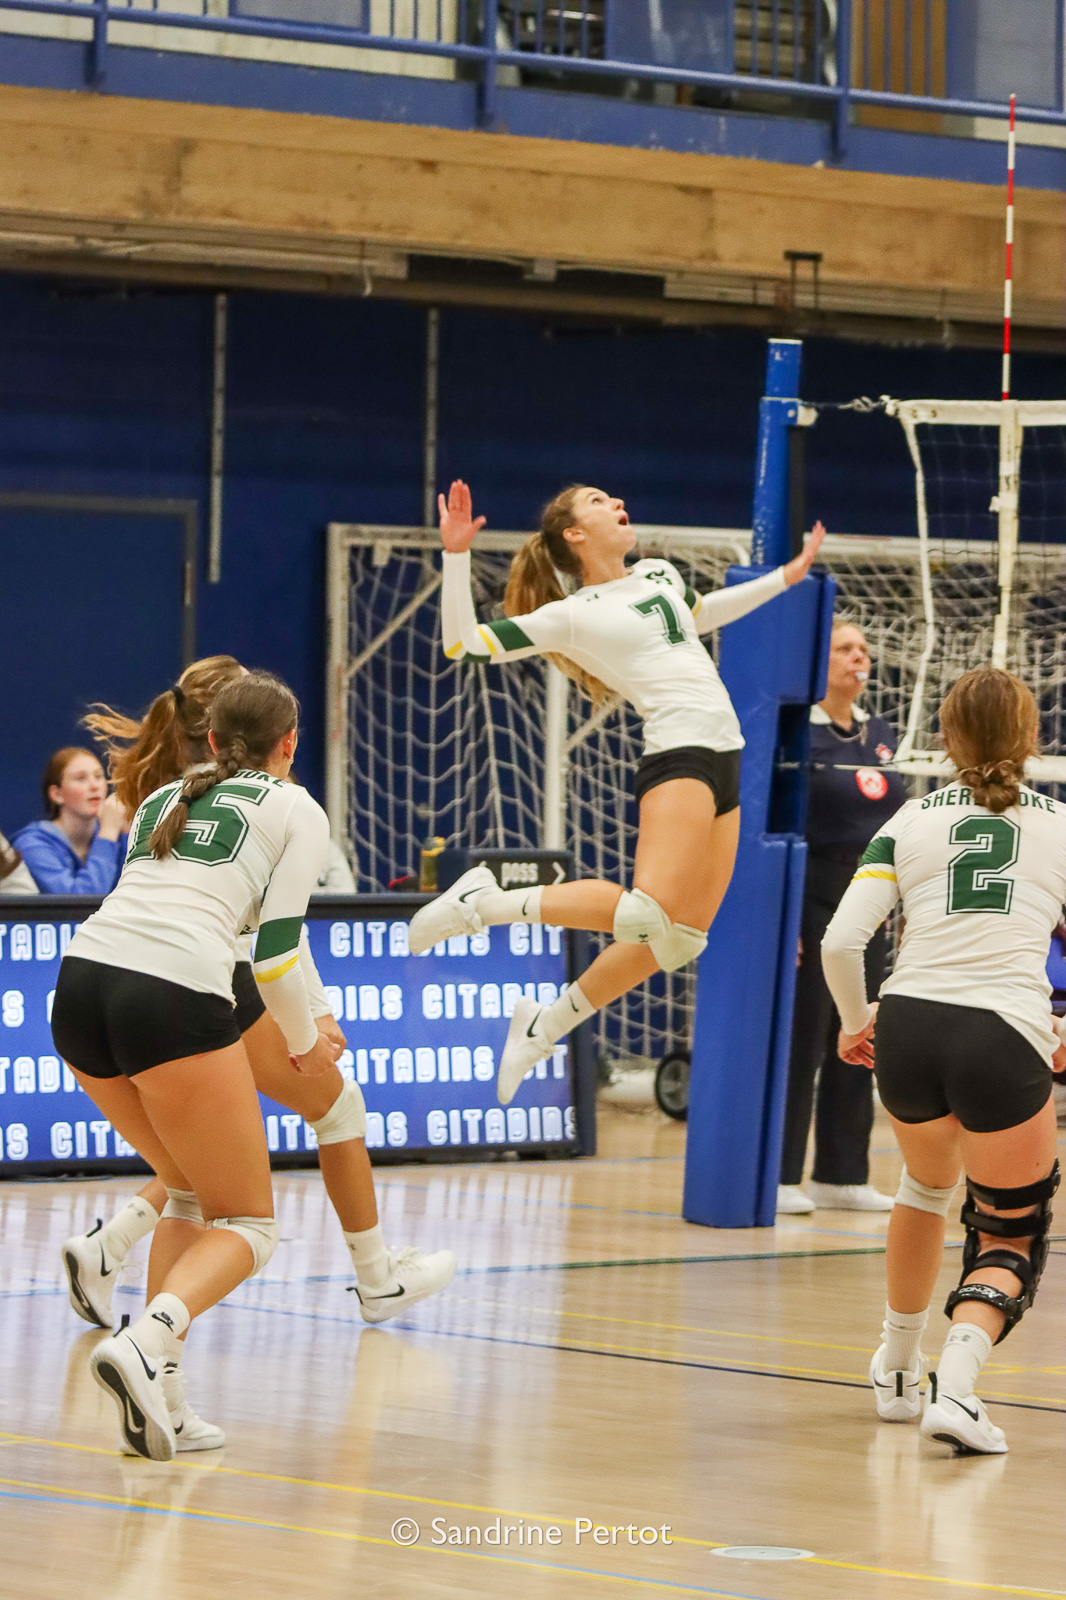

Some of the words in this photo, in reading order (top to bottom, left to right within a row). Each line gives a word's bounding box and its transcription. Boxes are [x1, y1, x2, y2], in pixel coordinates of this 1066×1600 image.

[627, 591, 691, 648] 7
[124, 782, 270, 868] 15
[921, 787, 1057, 814] SHEROKE
[946, 815, 1021, 915] 2
[0, 923, 82, 961] ADI
[329, 921, 490, 958] CITANS
[422, 982, 570, 1020] CITADIN
[0, 1055, 85, 1094] ADI
[336, 1045, 495, 1085] CITADINS
[523, 1043, 568, 1080] IT
